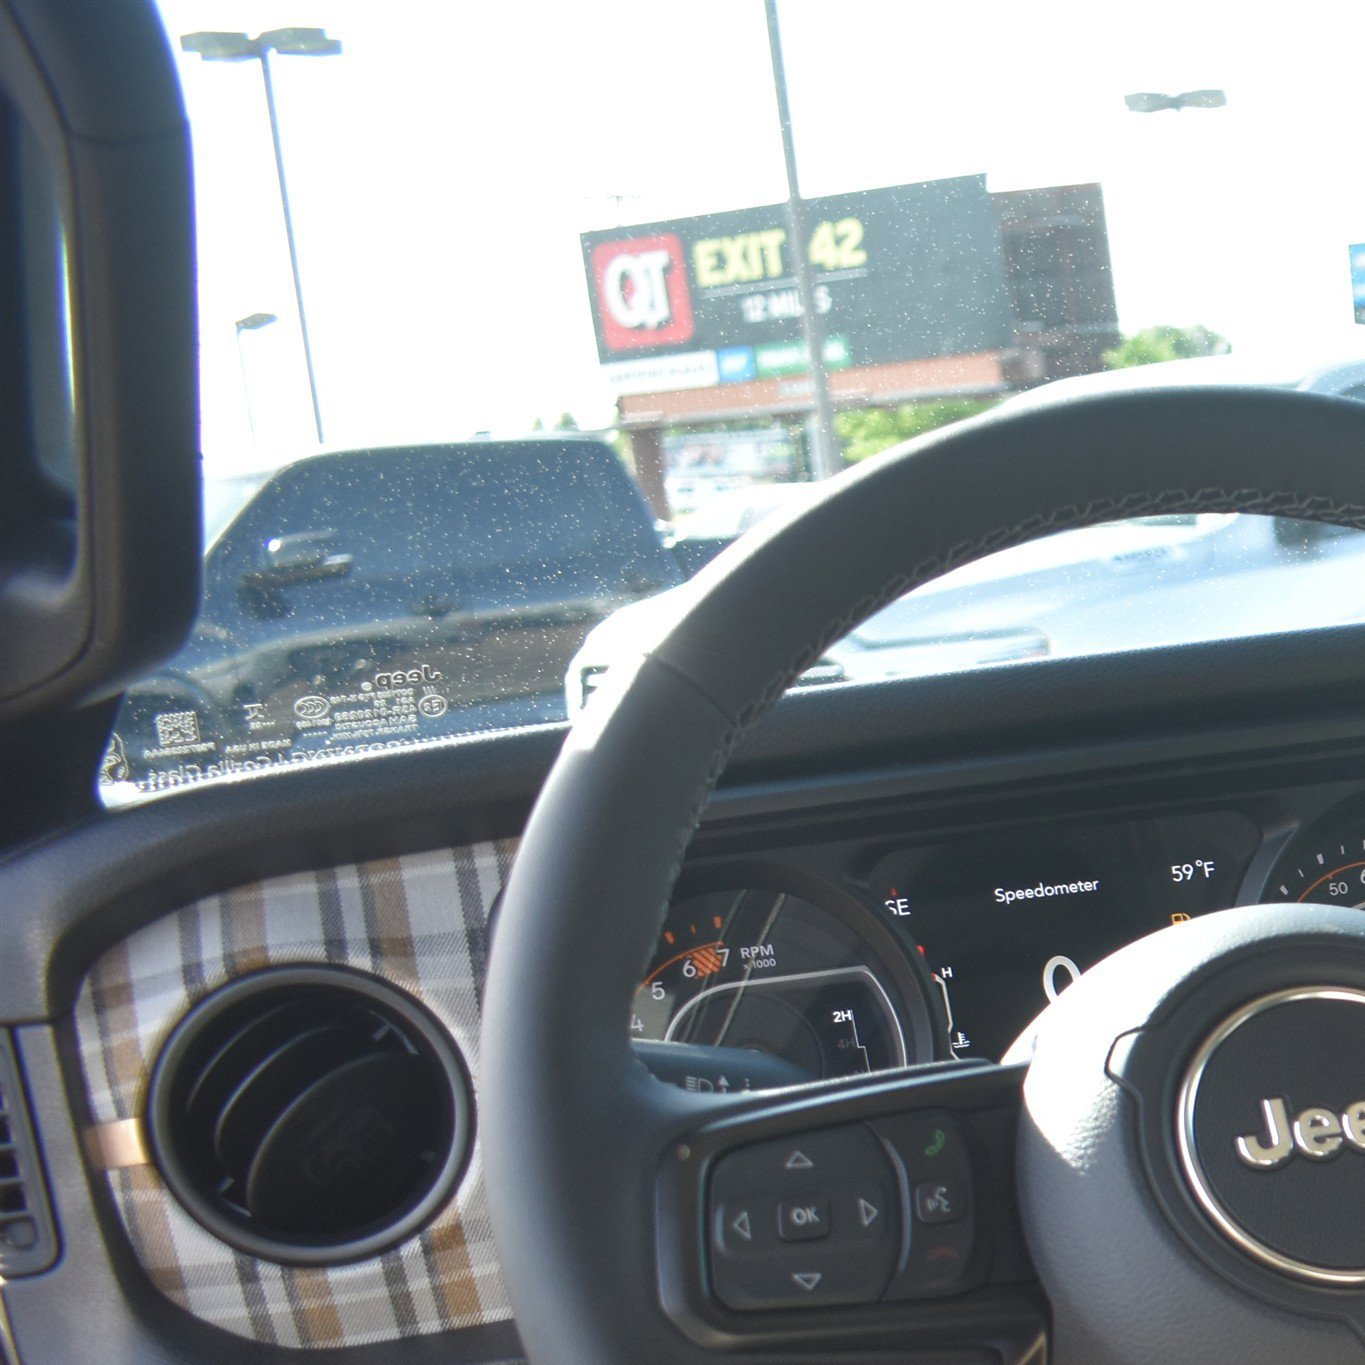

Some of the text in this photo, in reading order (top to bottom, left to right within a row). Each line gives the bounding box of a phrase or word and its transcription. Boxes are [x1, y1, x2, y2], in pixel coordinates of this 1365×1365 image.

[692, 217, 868, 289] EXIT 42
[604, 250, 671, 329] QT
[769, 286, 832, 318] MILS
[1171, 860, 1215, 882] 59°F
[995, 879, 1099, 904] Speedometer
[1329, 882, 1348, 896] 50
[716, 949, 730, 967] 7
[740, 944, 775, 959] RPM
[683, 960, 697, 978] 6
[942, 967, 953, 979] H
[651, 982, 665, 1000] 5
[630, 1014, 644, 1032] 4
[833, 1010, 853, 1024] 2H
[791, 1206, 820, 1225] OK
